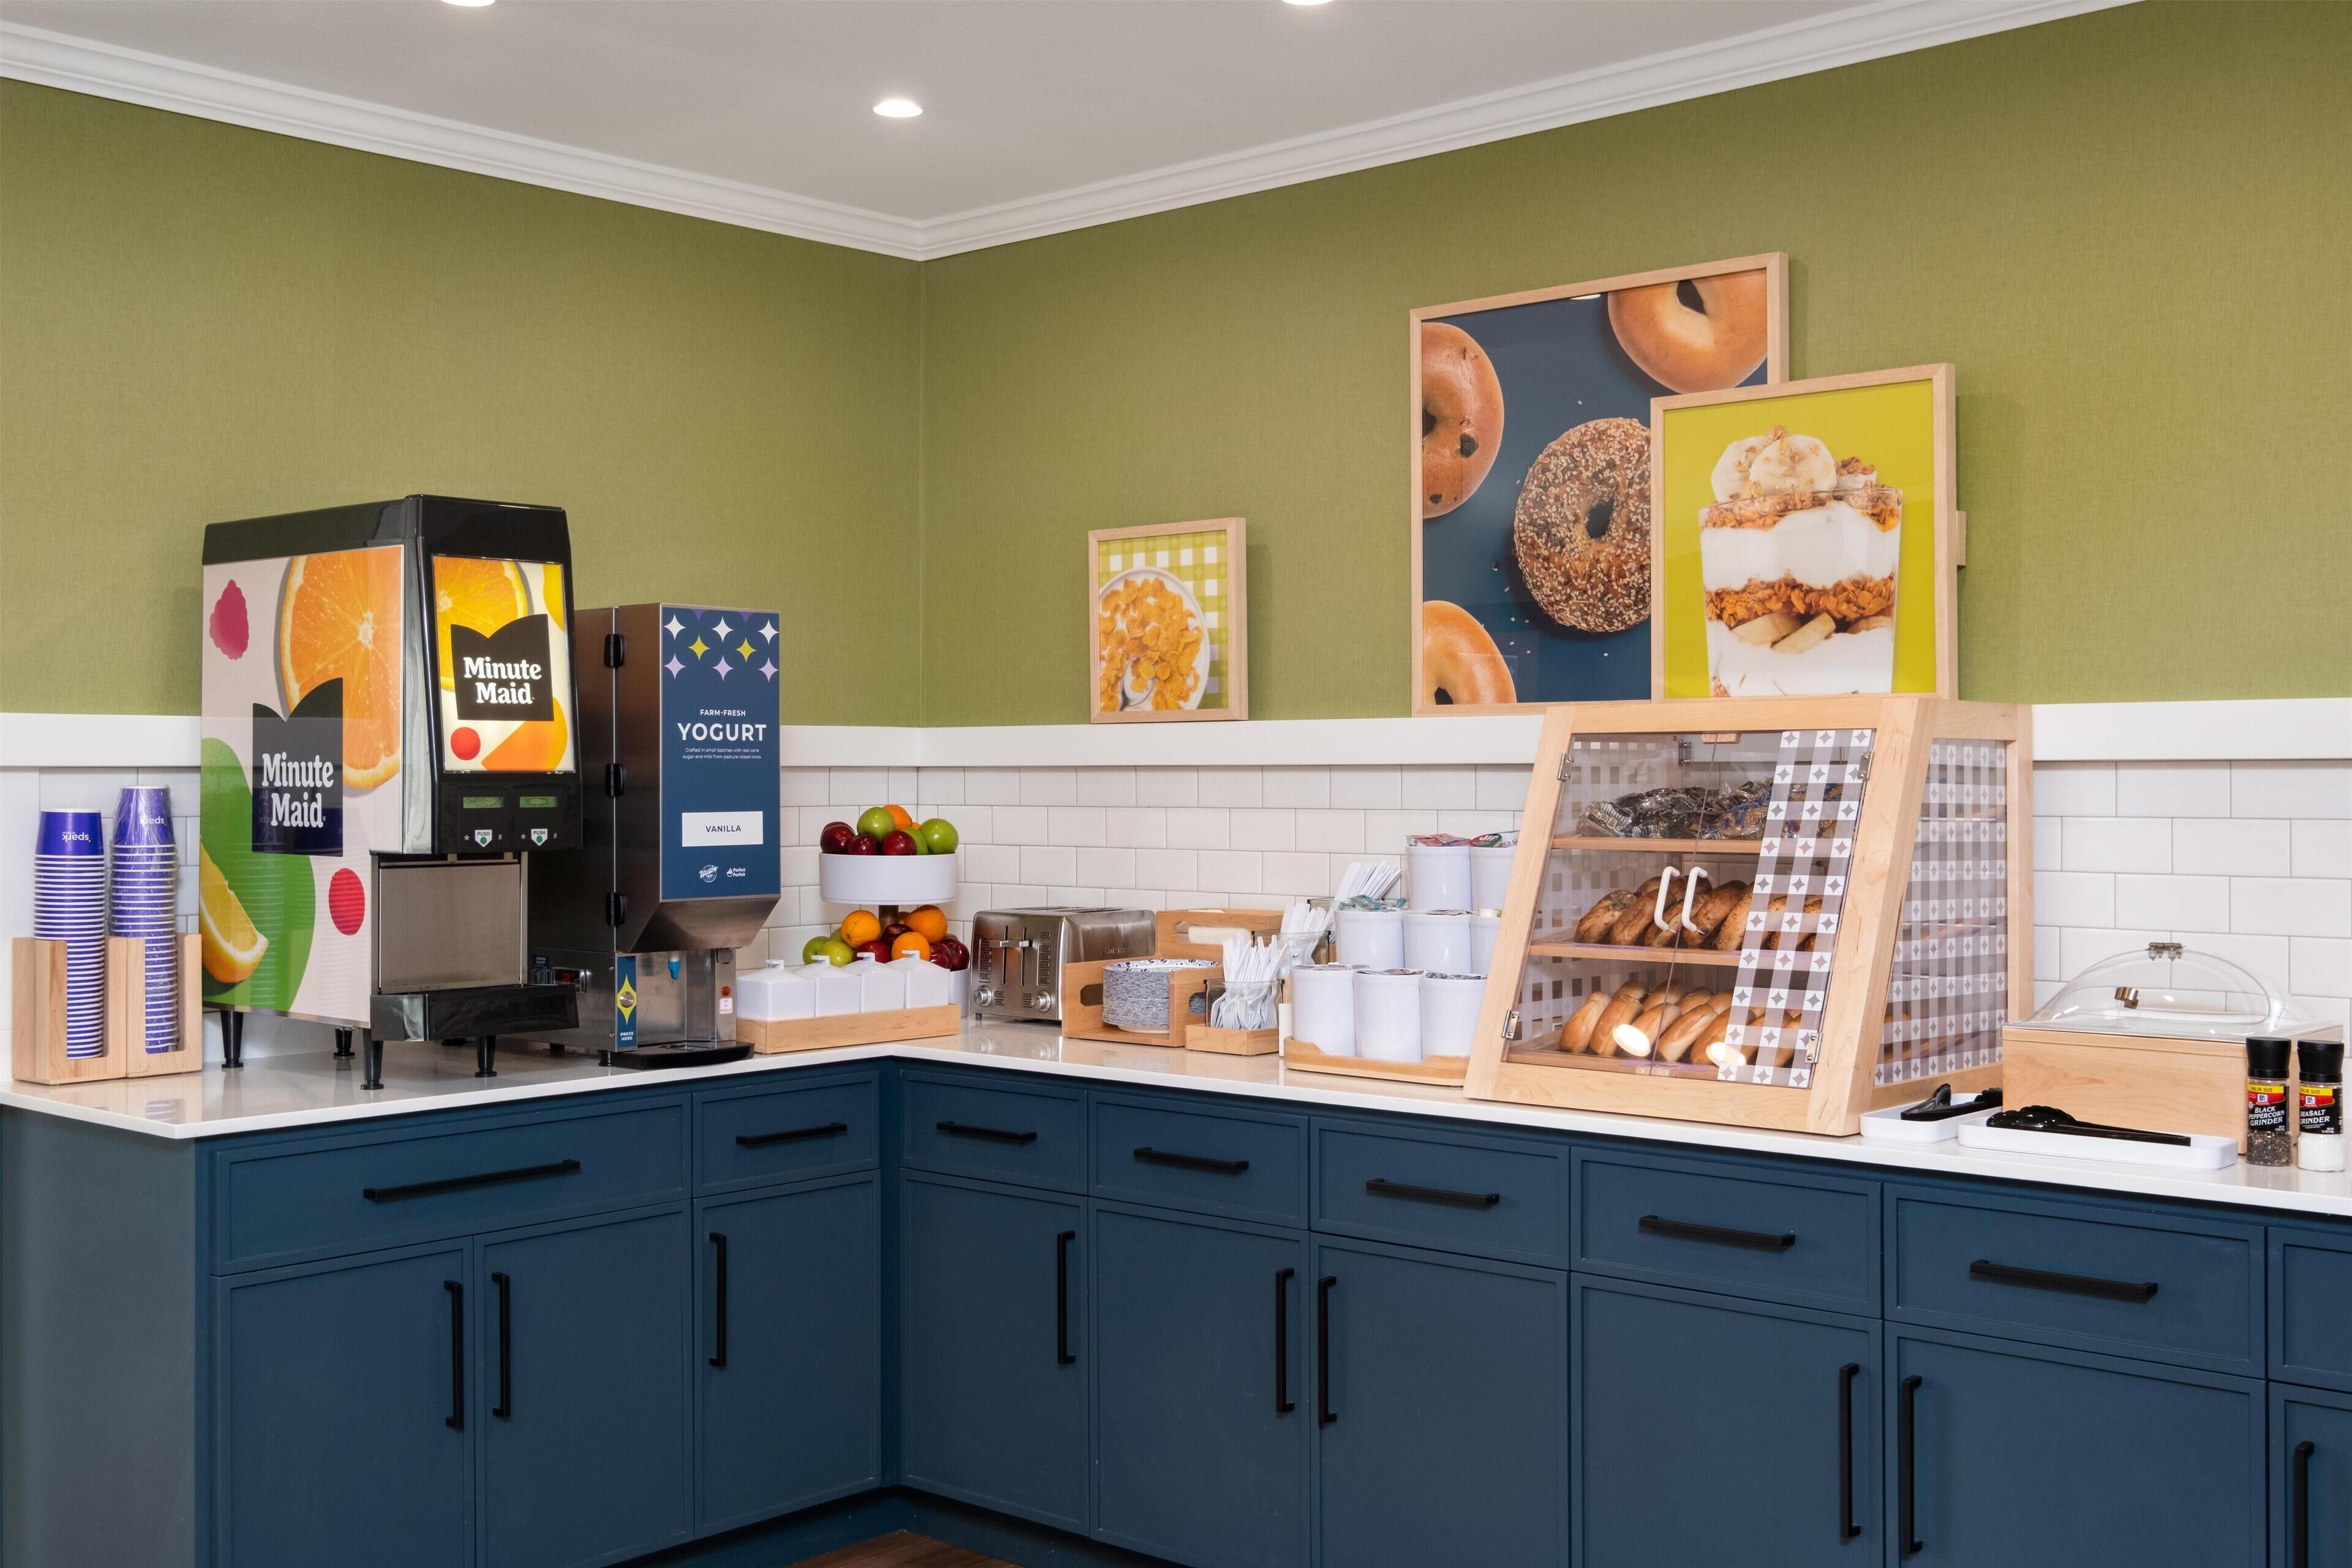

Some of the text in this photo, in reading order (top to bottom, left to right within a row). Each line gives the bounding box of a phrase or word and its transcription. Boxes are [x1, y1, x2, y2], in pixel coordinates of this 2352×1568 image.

[463, 657, 542, 680] Minute
[475, 682, 533, 704] Maid
[677, 723, 767, 741] YOGURT
[262, 752, 334, 788] Minute
[271, 791, 324, 828] Maid
[62, 832, 89, 843] spark
[2248, 1110, 2285, 1120] PEPPERCORN
[2250, 1117, 2283, 1126] GRINDER
